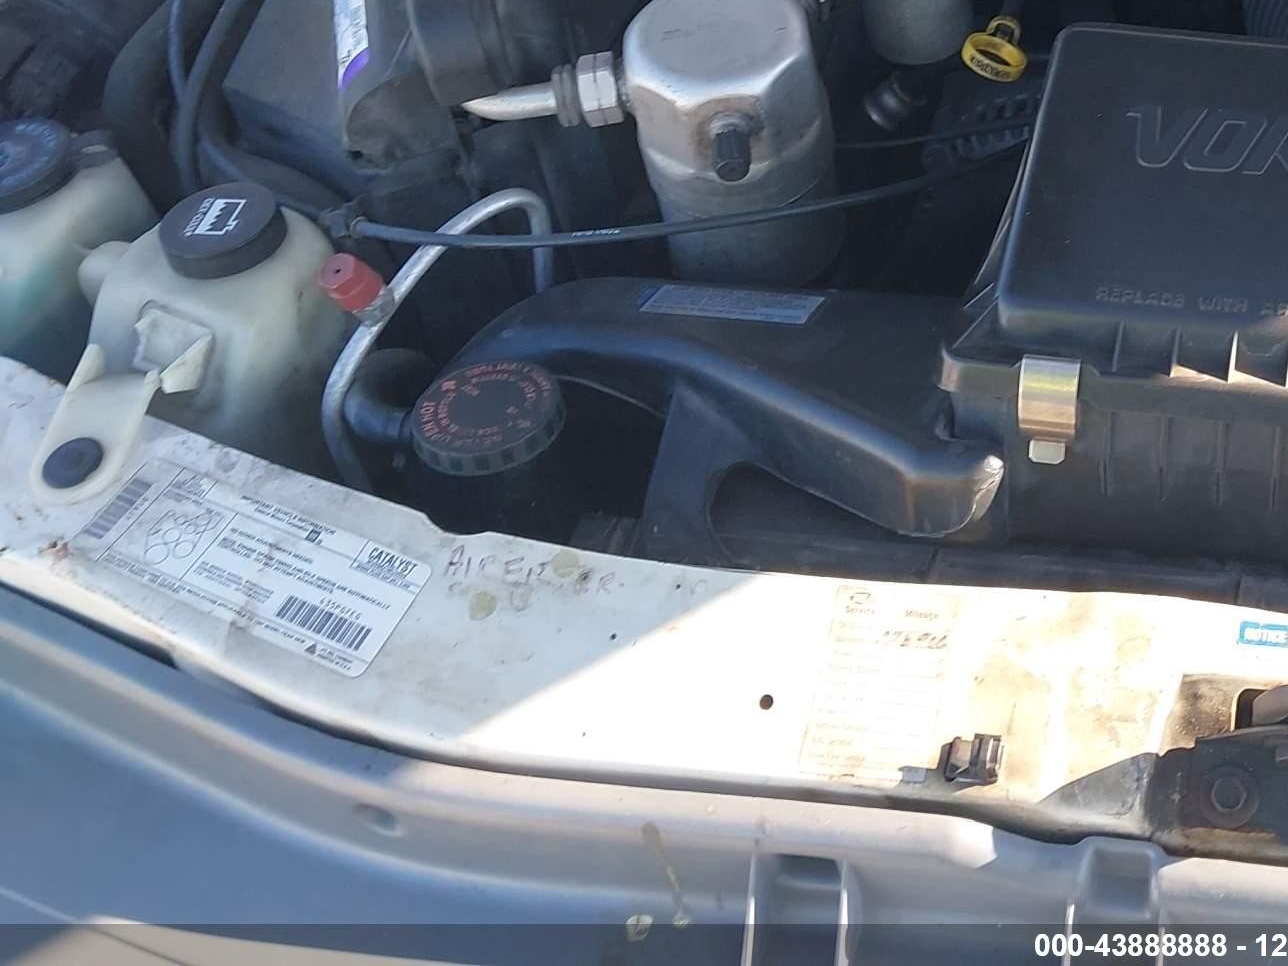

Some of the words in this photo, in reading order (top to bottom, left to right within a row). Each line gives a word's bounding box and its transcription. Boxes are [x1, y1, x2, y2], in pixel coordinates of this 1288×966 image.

[1096, 286, 1186, 309] REPLACE
[1199, 296, 1248, 314] WITH
[368, 546, 418, 575] CATALYST
[845, 604, 876, 615] Service
[904, 609, 939, 622] Mileage
